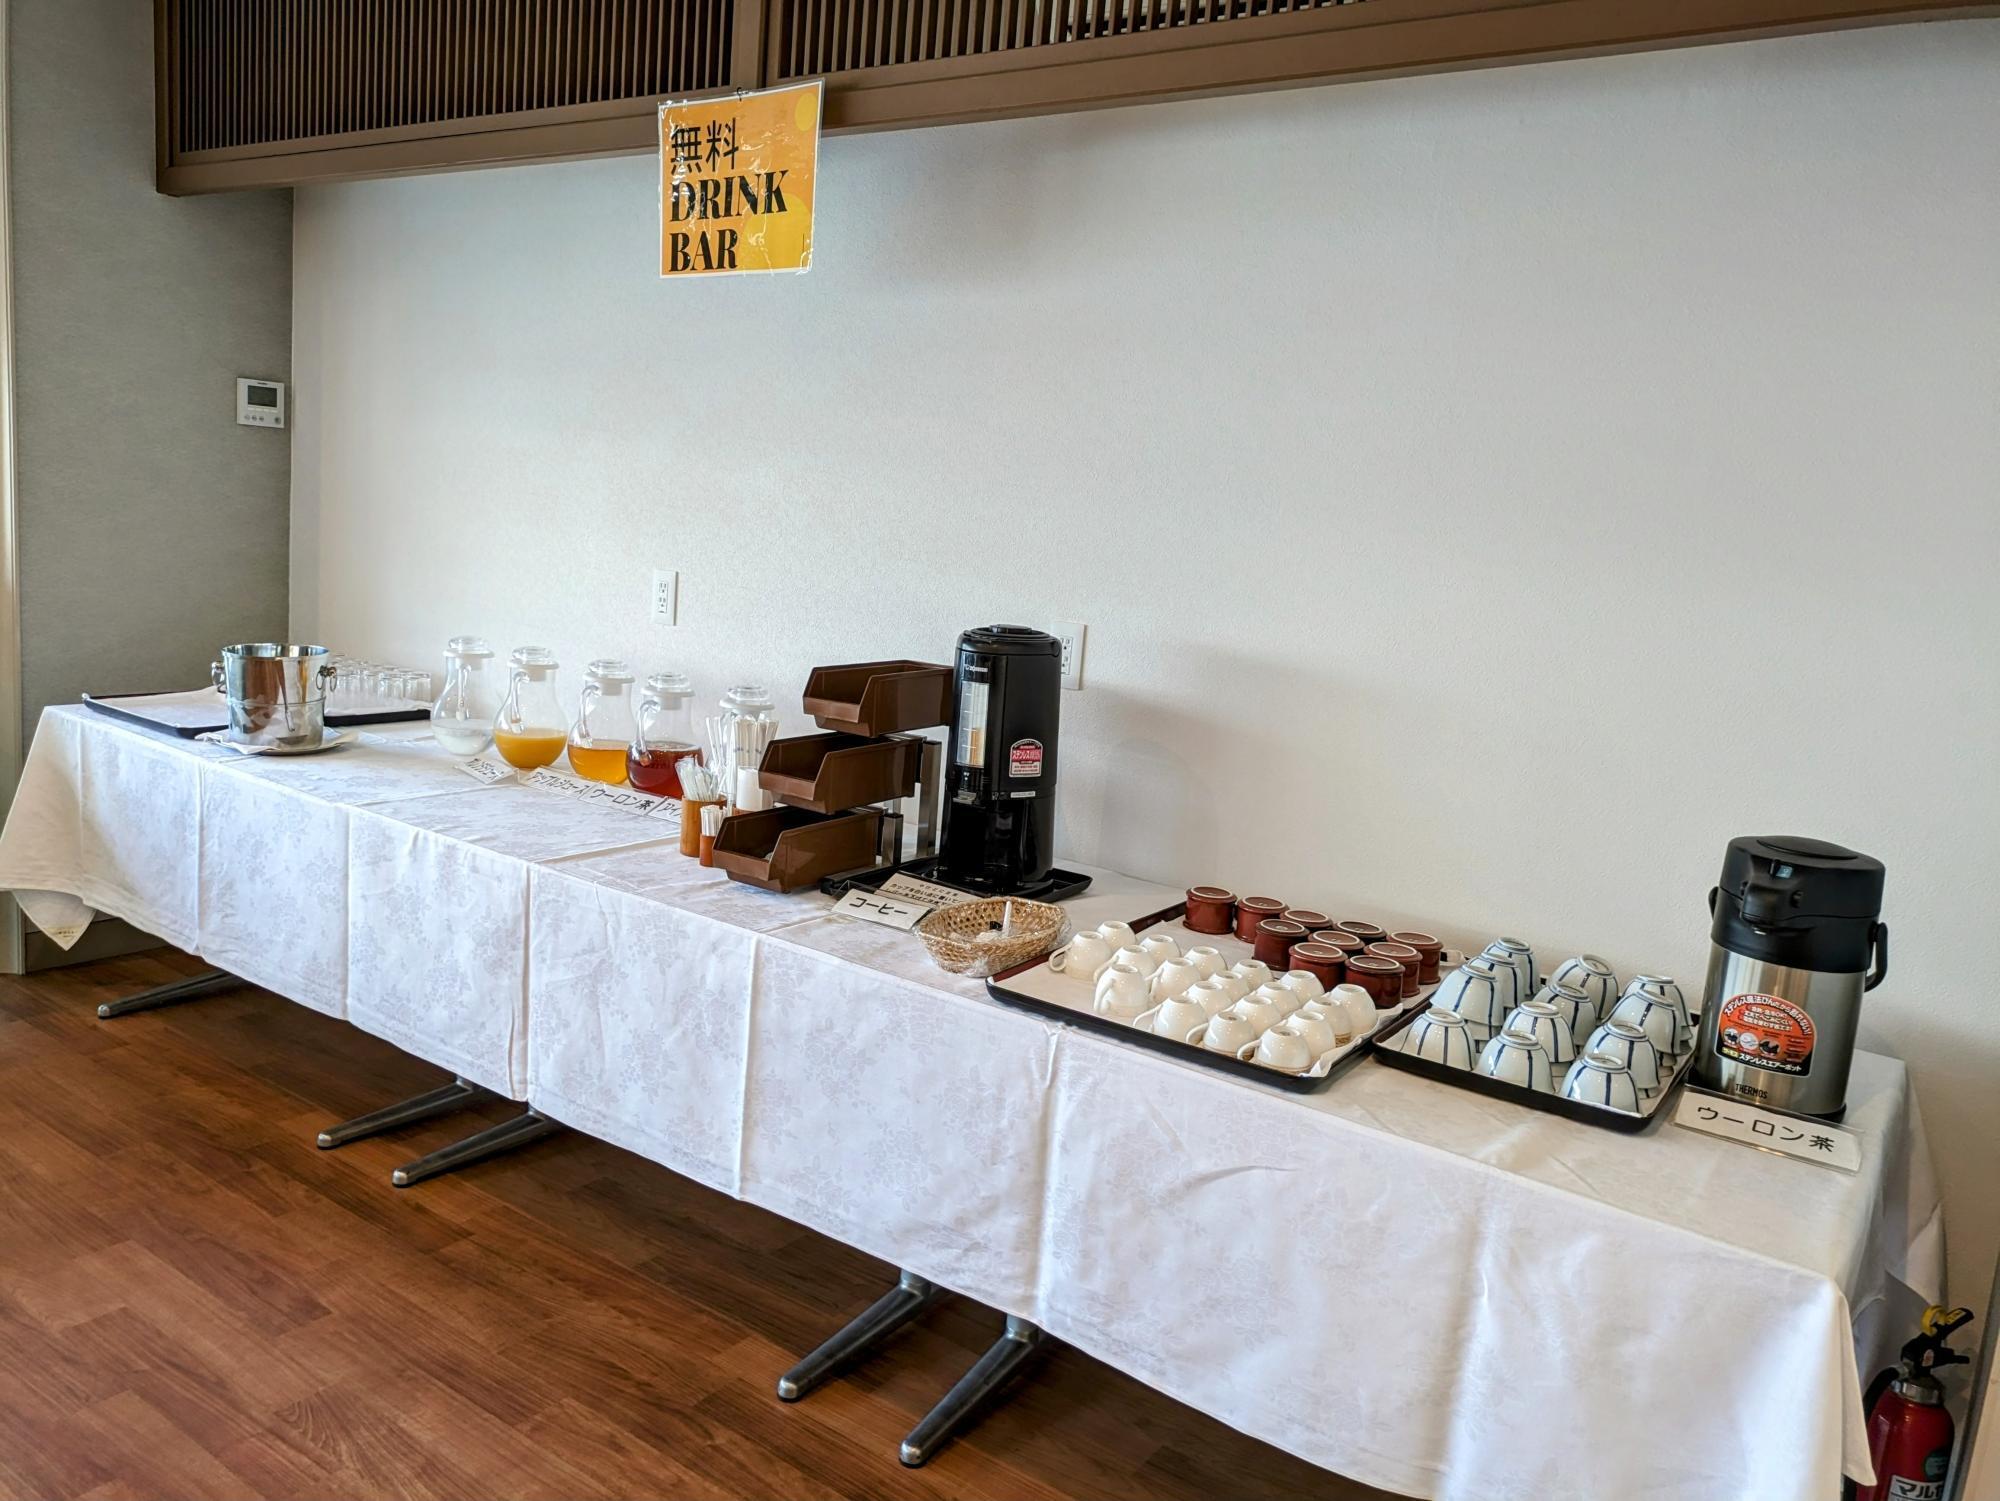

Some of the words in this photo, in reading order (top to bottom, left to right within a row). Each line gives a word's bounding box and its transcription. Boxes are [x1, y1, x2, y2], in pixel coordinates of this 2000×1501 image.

[670, 117, 739, 175] 無料
[670, 170, 789, 222] DRINK
[669, 228, 739, 272] BAR
[527, 772, 590, 795] アップルジュース
[590, 788, 655, 811] ウーロン茶
[849, 896, 909, 916] コーヒー
[1735, 1083, 1768, 1099] THERMOS
[1697, 1106, 1835, 1152] ウーロン茶
